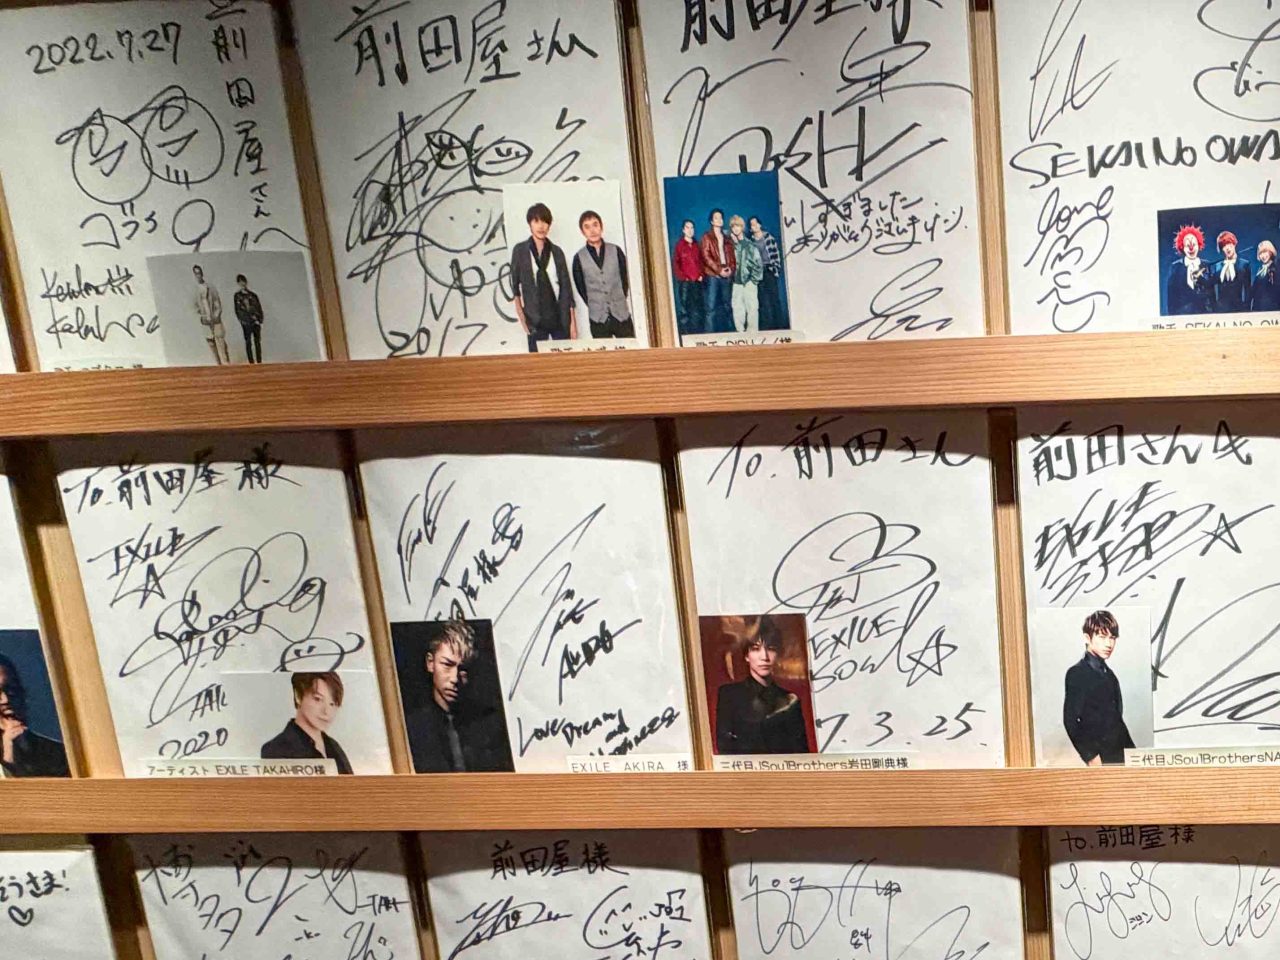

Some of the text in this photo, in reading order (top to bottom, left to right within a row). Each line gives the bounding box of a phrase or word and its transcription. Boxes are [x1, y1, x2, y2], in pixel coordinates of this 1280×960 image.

[147, 766, 209, 776] アーティスト
[571, 760, 689, 773] EXILE AKIRA 様
[1098, 825, 1198, 850] 前田屋様
[490, 840, 630, 881] 前田屋様
